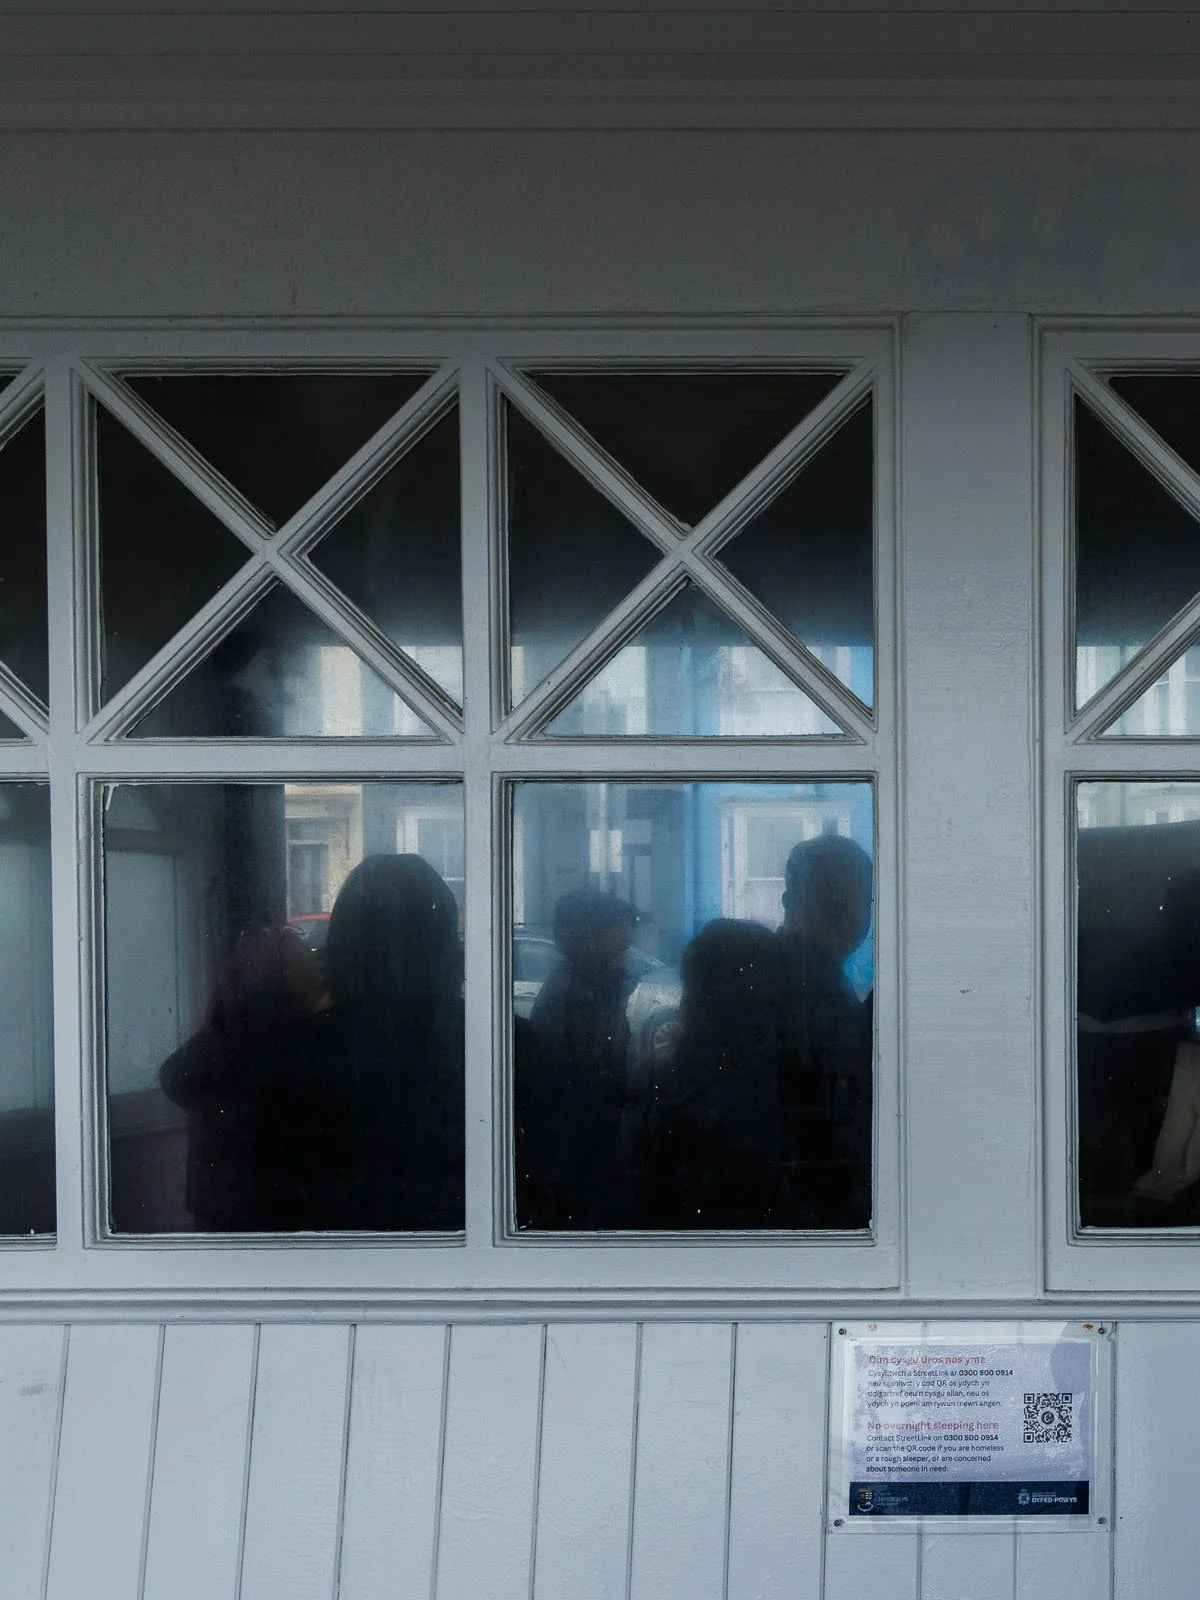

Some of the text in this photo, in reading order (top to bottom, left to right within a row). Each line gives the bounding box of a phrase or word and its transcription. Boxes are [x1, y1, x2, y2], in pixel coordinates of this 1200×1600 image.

[869, 1355, 888, 1363] Dim
[890, 1357, 919, 1366] cysgu
[921, 1355, 945, 1363] dros
[964, 1357, 986, 1366] yma
[957, 1380, 979, 1388] ydych
[867, 1401, 889, 1409] ydych
[900, 1401, 920, 1409] poeni
[867, 1421, 999, 1432] No overnight sleeping here
[943, 1446, 957, 1454] you
[881, 1455, 901, 1464] rough
[902, 1455, 931, 1464] sleeper,
